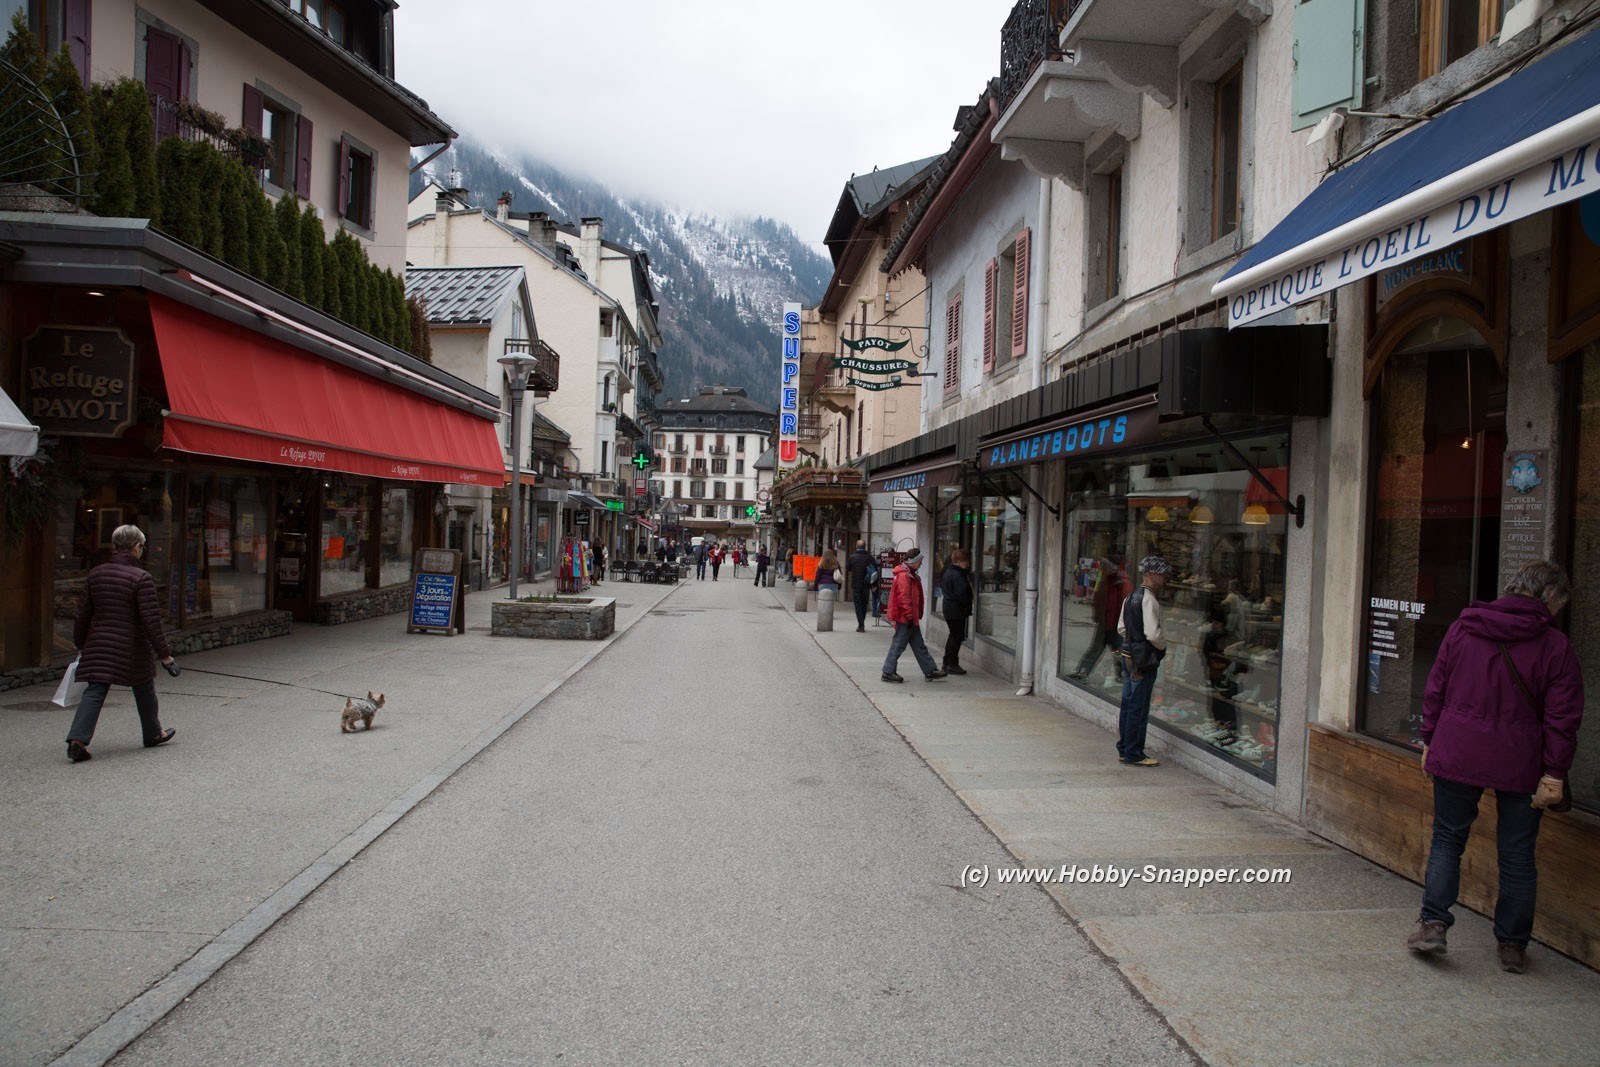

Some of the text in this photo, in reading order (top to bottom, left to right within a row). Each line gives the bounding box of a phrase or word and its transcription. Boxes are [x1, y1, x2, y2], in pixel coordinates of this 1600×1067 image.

[1231, 143, 1600, 321] OPTIQUE L'OEIL DU M
[1384, 245, 1465, 295] MONT-BLANC
[62, 335, 95, 358] Le
[858, 338, 892, 349] PAYOT
[781, 311, 800, 435] SUPER
[841, 359, 909, 371] CHAUSSURES
[28, 365, 125, 398] Refuge
[854, 379, 877, 389] Depuis
[31, 397, 123, 421] PAYOT
[990, 415, 1128, 466] PLANETBOOTS
[280, 446, 287, 457] Le
[289, 447, 307, 462] Refuge
[780, 440, 797, 461] U
[1507, 533, 1537, 543] OPTIQUE
[416, 592, 451, 601] Dégustation
[421, 585, 426, 594] 3
[427, 586, 444, 595] jours
[1370, 597, 1426, 614] EXAMEN DE VUE
